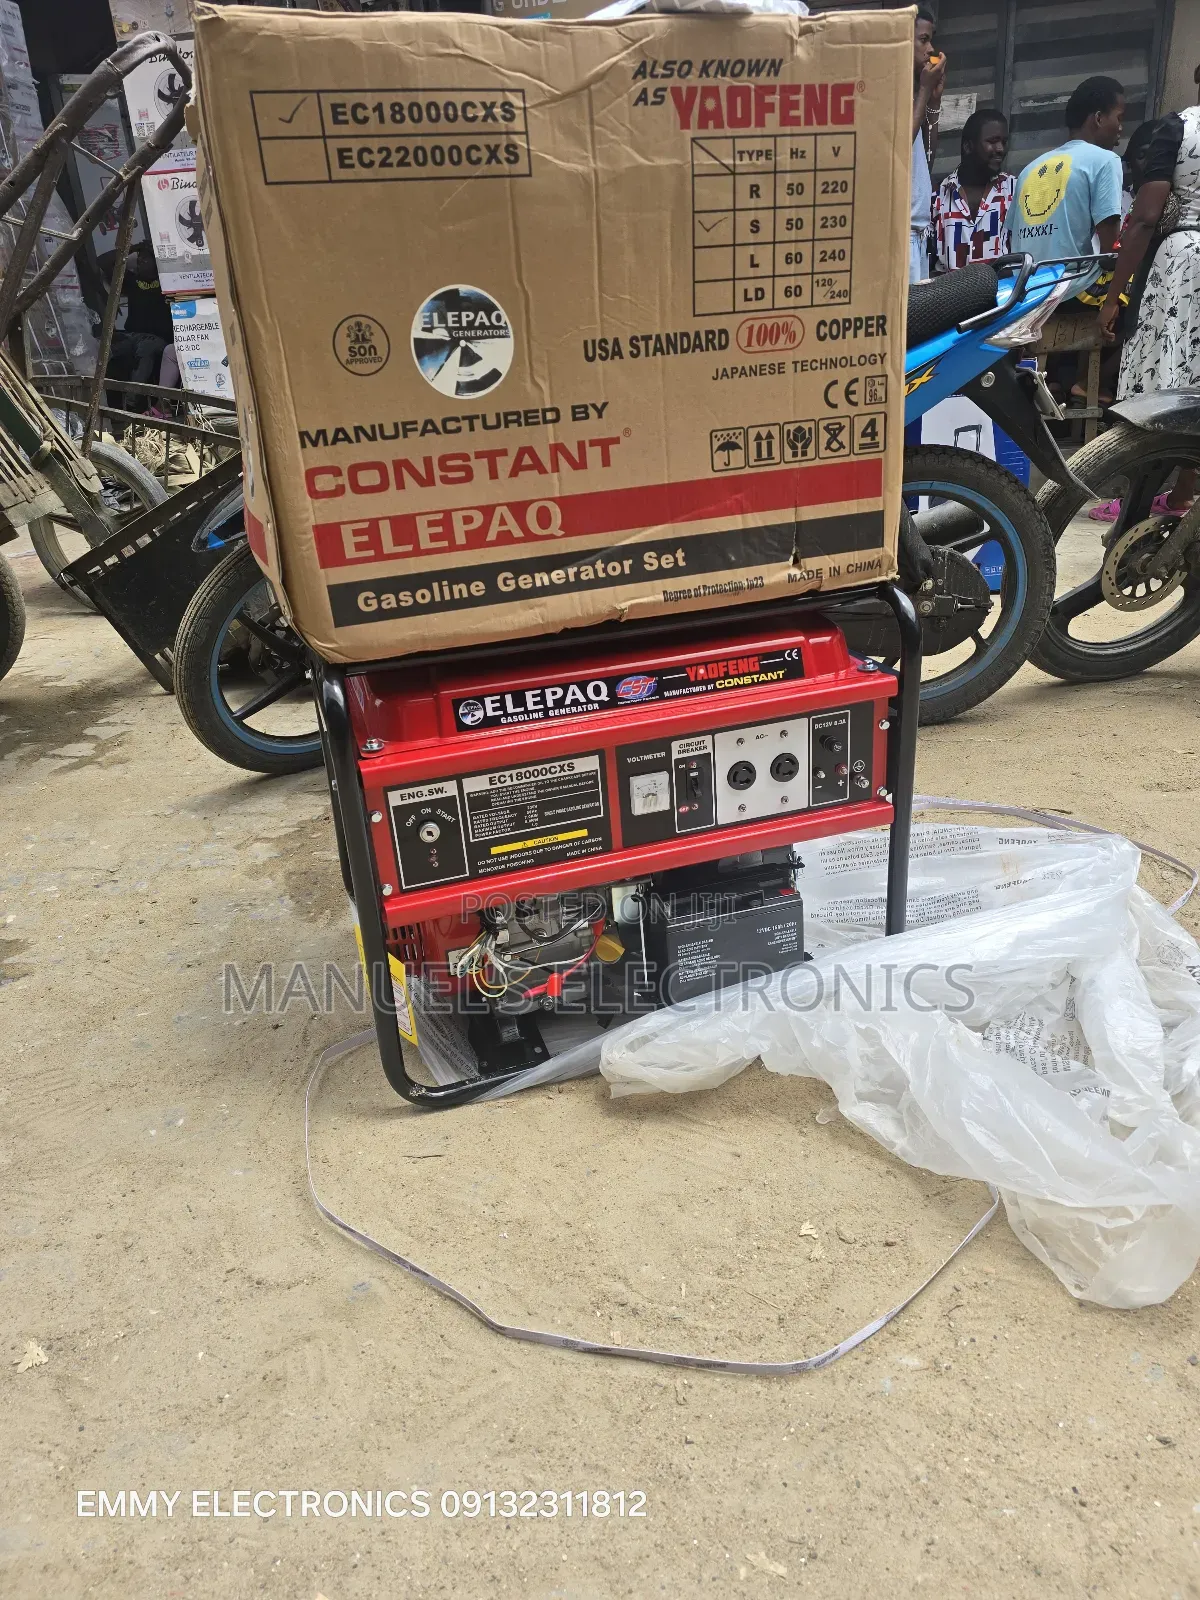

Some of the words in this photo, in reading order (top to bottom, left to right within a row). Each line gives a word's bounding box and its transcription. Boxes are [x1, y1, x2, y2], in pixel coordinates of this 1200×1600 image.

[632, 59, 693, 80] ALSO
[698, 58, 784, 78] KNOWN
[632, 86, 668, 106] AS
[330, 101, 516, 125] EC18000CXS
[337, 143, 520, 169] EC22000CXS
[737, 149, 773, 161] TYPE
[790, 148, 806, 160] Hz
[832, 146, 842, 158] V
[750, 184, 761, 199] R
[786, 182, 804, 196] 50
[821, 180, 848, 194] 220
[750, 219, 760, 234] S
[785, 217, 804, 231] 50
[820, 215, 847, 229] 230
[750, 254, 759, 268] L
[785, 252, 803, 265] 60
[819, 249, 846, 262] 240
[743, 287, 765, 302] LD
[784, 285, 802, 298] 60
[420, 310, 508, 328] ELEPAQ
[196, 333, 209, 341] FAN
[452, 328, 511, 338] GENERATORS
[583, 337, 624, 363] USA
[629, 328, 730, 359] STANDARD
[744, 320, 797, 348] 100%
[815, 314, 888, 342] COPPER
[345, 356, 383, 366] APPROVED
[712, 361, 786, 381] JAPANESE
[792, 352, 887, 374] TECHNOLOGY
[298, 405, 561, 449] MANUFACTURED
[571, 401, 610, 422] BY
[340, 500, 566, 560] ELEPAQ
[357, 579, 486, 612] Gasoline
[496, 557, 633, 592] Generator
[643, 547, 687, 572] Set
[787, 568, 824, 584] MADE
[829, 565, 841, 578] IN
[846, 559, 882, 574] CHINA
[662, 588, 693, 602] Degree
[693, 585, 701, 598] of
[685, 656, 761, 682] YAOFENG
[784, 649, 799, 660] CE
[715, 670, 786, 690] CONSTANT
[483, 680, 611, 717] ELEPAQ
[501, 711, 545, 724] GASOLINE
[548, 703, 600, 717] GENERATOR
[677, 745, 708, 755] BREAKER
[678, 739, 706, 749] CIRCUIT
[626, 751, 666, 763] VOLTMETER
[488, 762, 576, 787] EC18000CXS
[400, 786, 448, 801] ENG.SW.
[405, 814, 416, 827] OFF
[420, 807, 432, 815] ON
[436, 808, 456, 824] START
[533, 836, 559, 846] CAUTION
